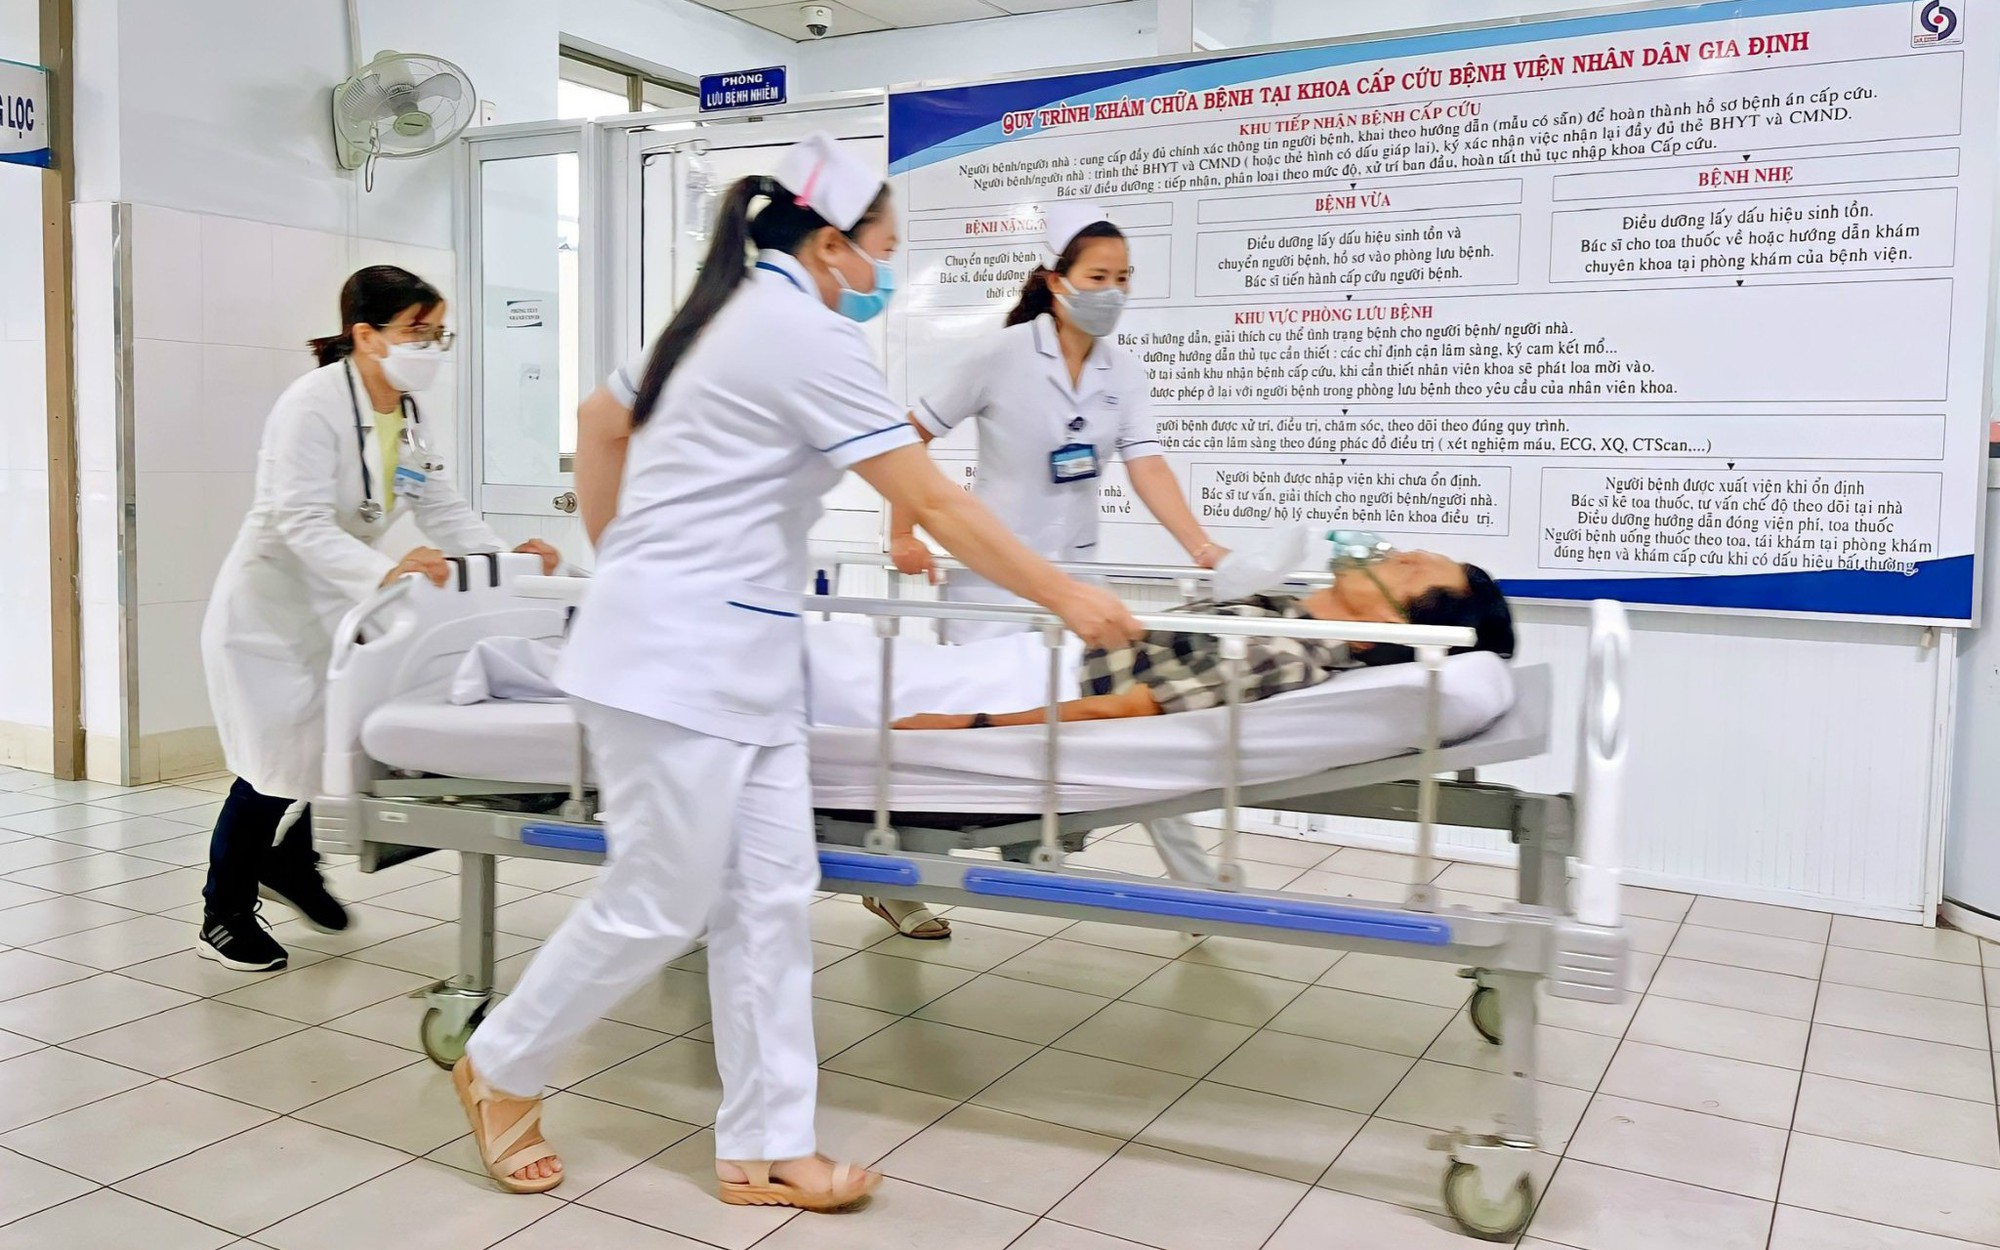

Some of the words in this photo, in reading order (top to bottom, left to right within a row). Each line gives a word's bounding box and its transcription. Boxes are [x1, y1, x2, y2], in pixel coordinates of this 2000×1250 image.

[722, 73, 763, 86] PHÒNG
[1003, 112, 1034, 132] QUY
[1040, 106, 1089, 125] TRÌNH
[1095, 99, 1144, 121] KHÁM
[1149, 93, 1198, 114] CHỮA
[1203, 88, 1254, 110] BỆNH
[1260, 85, 1291, 106] TẠI
[1297, 78, 1351, 100] KHOA
[1356, 69, 1396, 94] CẤP
[1401, 68, 1440, 91] CỨU
[1449, 63, 1506, 87] BỆNH
[1513, 53, 1564, 78] VIỆN
[1572, 48, 1634, 74] NHÂN
[1642, 43, 1690, 67] DÂN
[1698, 39, 1740, 59] GIA
[1748, 30, 1811, 56] ĐỊNH
[707, 91, 723, 106] LƯU
[725, 88, 748, 106] BỆNH
[750, 82, 778, 101] NHIỄM
[8, 95, 34, 139] LỌC
[1240, 122, 1271, 135] KHU
[1274, 113, 1310, 132] TIẾP
[1313, 112, 1357, 129] NHẬN
[1361, 109, 1405, 126] BỆNH
[1409, 99, 1442, 121] CẤP
[1446, 98, 1481, 118] CỨU
[1698, 167, 1749, 188] BỆNH
[1754, 166, 1793, 183] NHẸ
[1315, 194, 1355, 213] BỆNH
[1360, 190, 1390, 207] VỪA
[965, 219, 998, 236] BỆNH
[1622, 213, 1656, 230] Điều
[1660, 214, 1705, 230] dưỡng
[1710, 208, 1732, 228] lấy
[1737, 206, 1764, 223] dấu
[1769, 206, 1802, 223] hiệu
[1807, 204, 1838, 219] sinh
[1844, 206, 1873, 217] tồn.
[1247, 234, 1274, 250] Điều
[1278, 235, 1313, 250] dưỡng
[1317, 231, 1335, 248] lấy
[1338, 229, 1360, 244] dấu
[1364, 230, 1391, 245] hiệu
[1394, 228, 1419, 242] sinh
[1423, 225, 1442, 240] tồn
[1447, 226, 1461, 238] và
[1581, 238, 1606, 252] Bác
[1610, 238, 1622, 251] sĩ
[1626, 236, 1650, 250] cho
[1655, 238, 1675, 249] toa
[1681, 230, 1720, 247] thuốc
[1725, 228, 1742, 245] về
[1748, 230, 1784, 246] hoặc
[1789, 227, 1836, 244] hướng
[1841, 222, 1869, 240] dẫn
[1875, 223, 1919, 238] khám
[1218, 254, 1258, 272] chuyển
[1262, 254, 1293, 271] người
[1333, 249, 1348, 264] hồ
[1351, 252, 1365, 263] sơ
[1368, 250, 1391, 262] vào
[1394, 248, 1431, 265] phòng
[1436, 247, 1454, 259] lưu
[1585, 258, 1634, 275] chuyên
[1639, 257, 1672, 270] khoa
[1677, 255, 1695, 272] tại
[1700, 254, 1745, 272] phòng
[1750, 251, 1791, 266] khám
[1796, 248, 1823, 264] của
[1829, 247, 1867, 265] bệnh
[1873, 246, 1912, 263] viện.
[1245, 274, 1266, 287] Bác
[1270, 274, 1279, 286] sĩ
[1282, 270, 1304, 286] tiến
[1308, 271, 1336, 285] hành
[1339, 268, 1361, 286] cấp
[1364, 269, 1386, 282] cứu
[1390, 267, 1424, 284] người
[1234, 311, 1264, 324] KHU
[1268, 308, 1298, 325] VỰC
[1301, 305, 1352, 322] PHÒNG
[1356, 305, 1386, 320] LƯU
[1390, 302, 1432, 321] BỆNH
[1150, 386, 1175, 398] được
[1177, 385, 1204, 401] phép
[1207, 384, 1214, 397] ở
[1217, 385, 1231, 399] lại
[1235, 385, 1252, 397] với
[1256, 384, 1287, 400] người
[1291, 384, 1319, 398] bệnh
[1323, 386, 1353, 399] trong
[1356, 382, 1393, 399] phòng
[1397, 382, 1416, 395] lưu
[1420, 382, 1450, 397] bệnh
[1454, 381, 1482, 395] theo
[1485, 381, 1509, 398] yêu
[1513, 378, 1536, 394] cầu
[1540, 379, 1563, 394] của
[1568, 380, 1601, 394] nhân
[1605, 379, 1635, 394] viên
[1605, 476, 1643, 494] Người
[1647, 477, 1678, 493] bệnh
[1682, 478, 1714, 494] được
[1718, 476, 1747, 492] xuất
[1752, 478, 1781, 493] viện
[1786, 479, 1807, 493] khi
[1811, 476, 1828, 494] ổn
[1833, 480, 1864, 497] định
[1571, 493, 1595, 507] Bác
[1598, 495, 1609, 507] sĩ
[1612, 494, 1627, 507] kê
[1631, 497, 1650, 508] toa
[1698, 498, 1711, 509] tư
[1714, 494, 1738, 510] vấn
[1742, 496, 1766, 511] chế
[1770, 498, 1787, 514] độ
[1793, 498, 1823, 512] theo
[1827, 499, 1849, 513] dõi
[1854, 499, 1872, 516] tại
[1877, 500, 1902, 514] nhà
[1577, 508, 1607, 524] Điều
[1611, 512, 1649, 530] dưỡng
[1654, 513, 1693, 531] hướng
[1697, 512, 1721, 528] dẫn
[1725, 515, 1758, 532] đóng
[1764, 515, 1793, 532] viện
[1828, 520, 1849, 531] toa
[1854, 516, 1893, 532] thuốc
